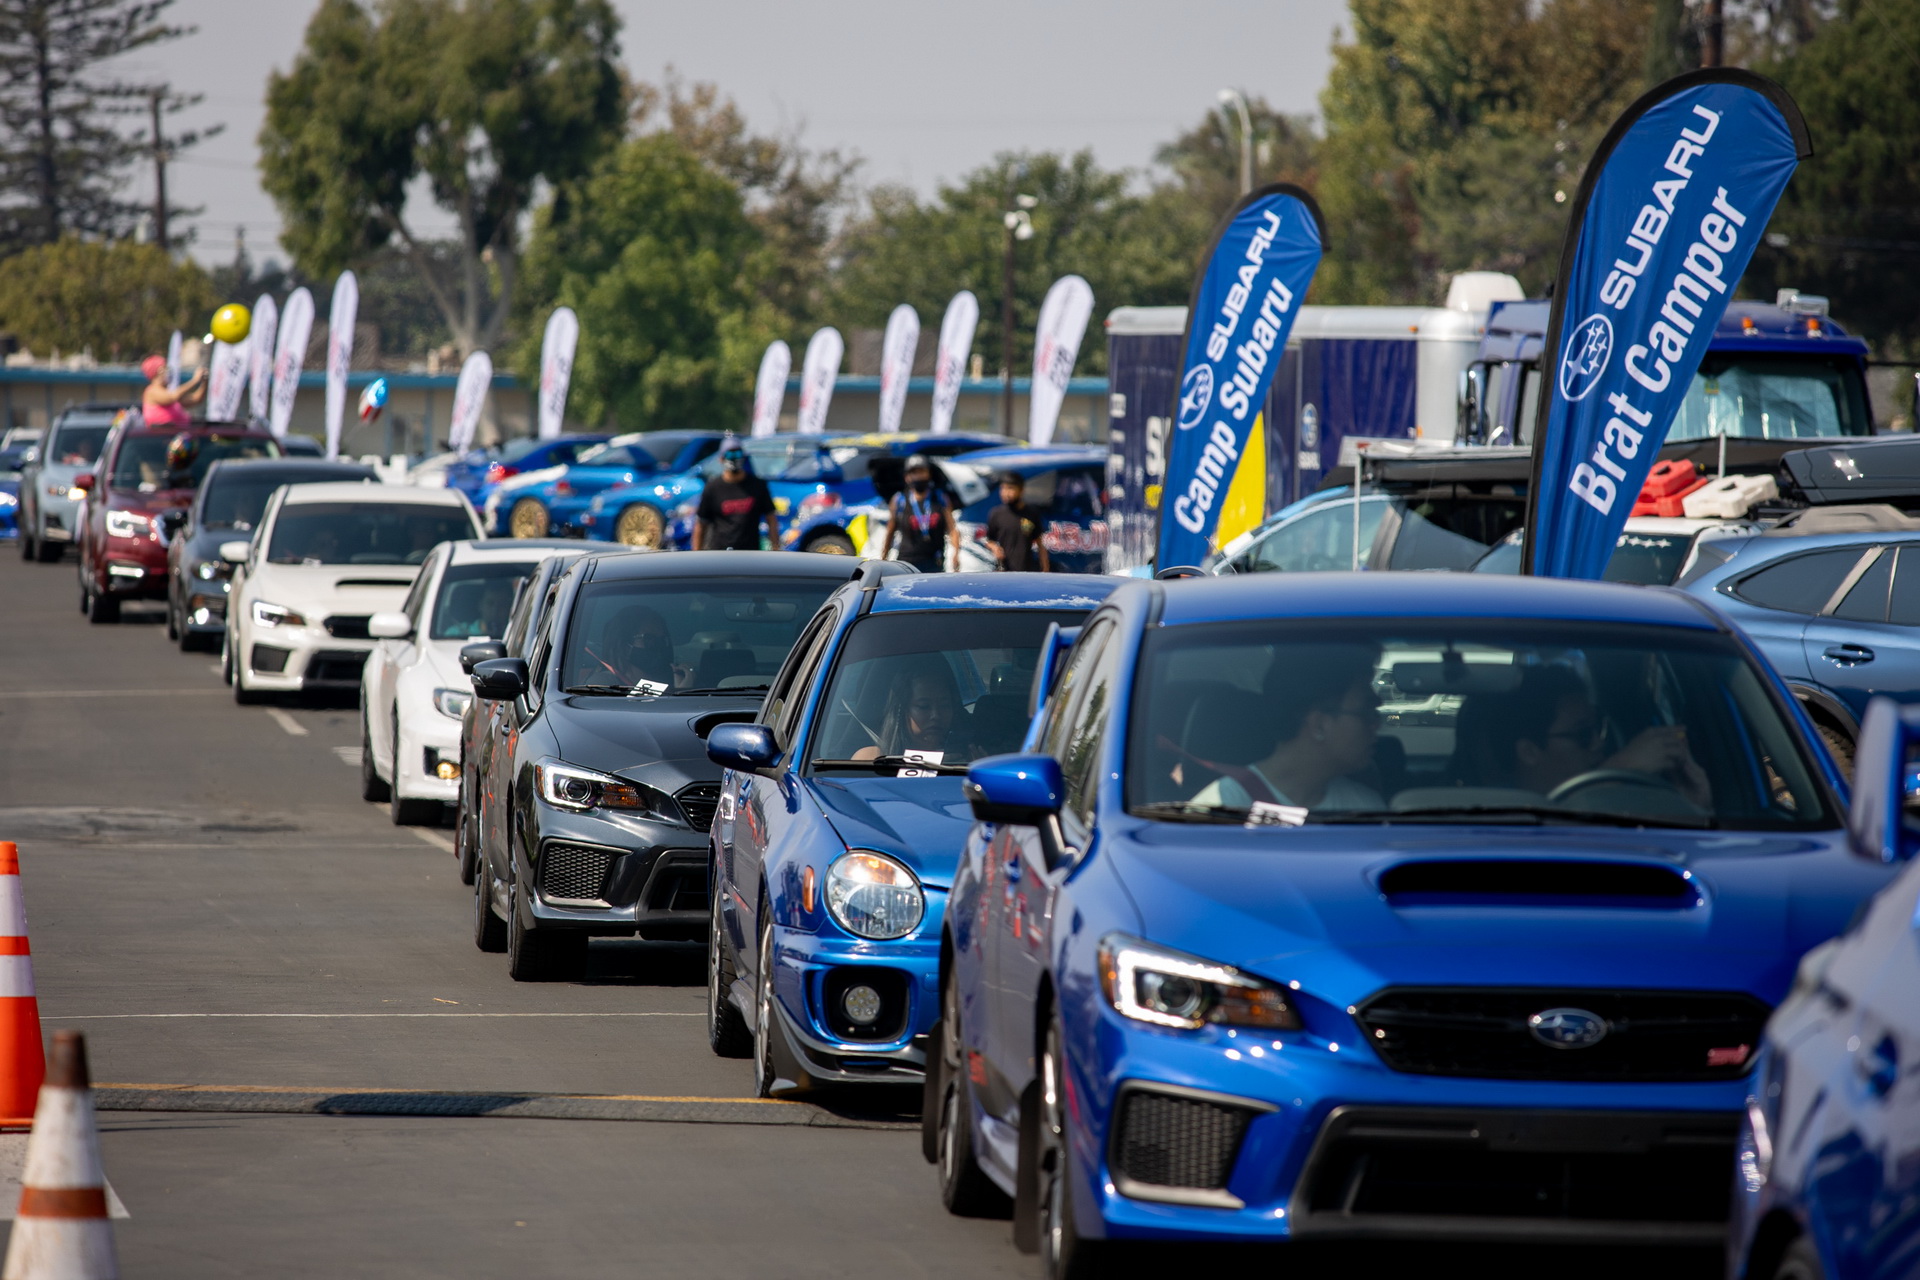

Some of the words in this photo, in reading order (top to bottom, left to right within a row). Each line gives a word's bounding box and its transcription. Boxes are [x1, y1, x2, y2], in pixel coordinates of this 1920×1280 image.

[1206, 209, 1281, 363] SUBARU
[1599, 104, 1720, 310] SUBARU
[1174, 420, 1238, 534] Camp
[1219, 277, 1293, 420] Subaru
[1567, 390, 1653, 516] Brat
[1624, 186, 1747, 393] Camper
